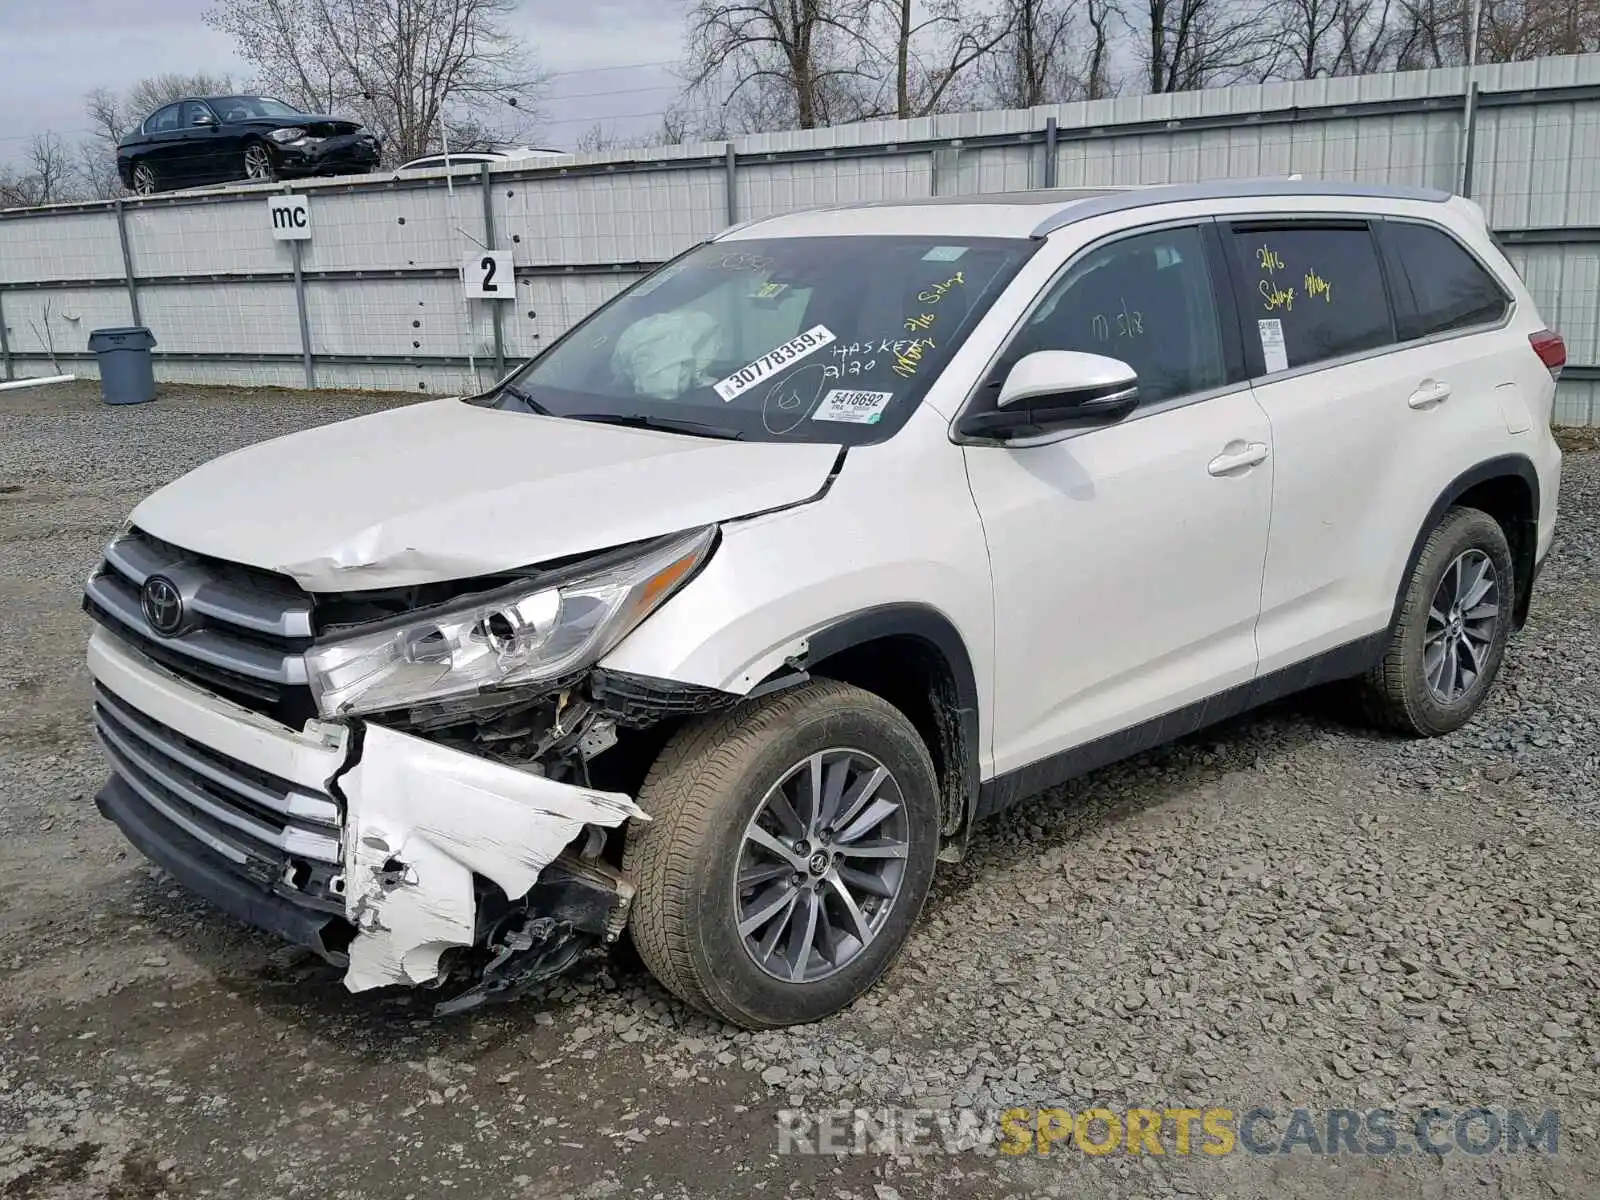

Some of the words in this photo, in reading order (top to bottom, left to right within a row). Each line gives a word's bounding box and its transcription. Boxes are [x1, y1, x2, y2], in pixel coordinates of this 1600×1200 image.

[480, 256, 498, 292] 2
[729, 333, 817, 389] 30778359
[831, 391, 884, 407] 5418692
